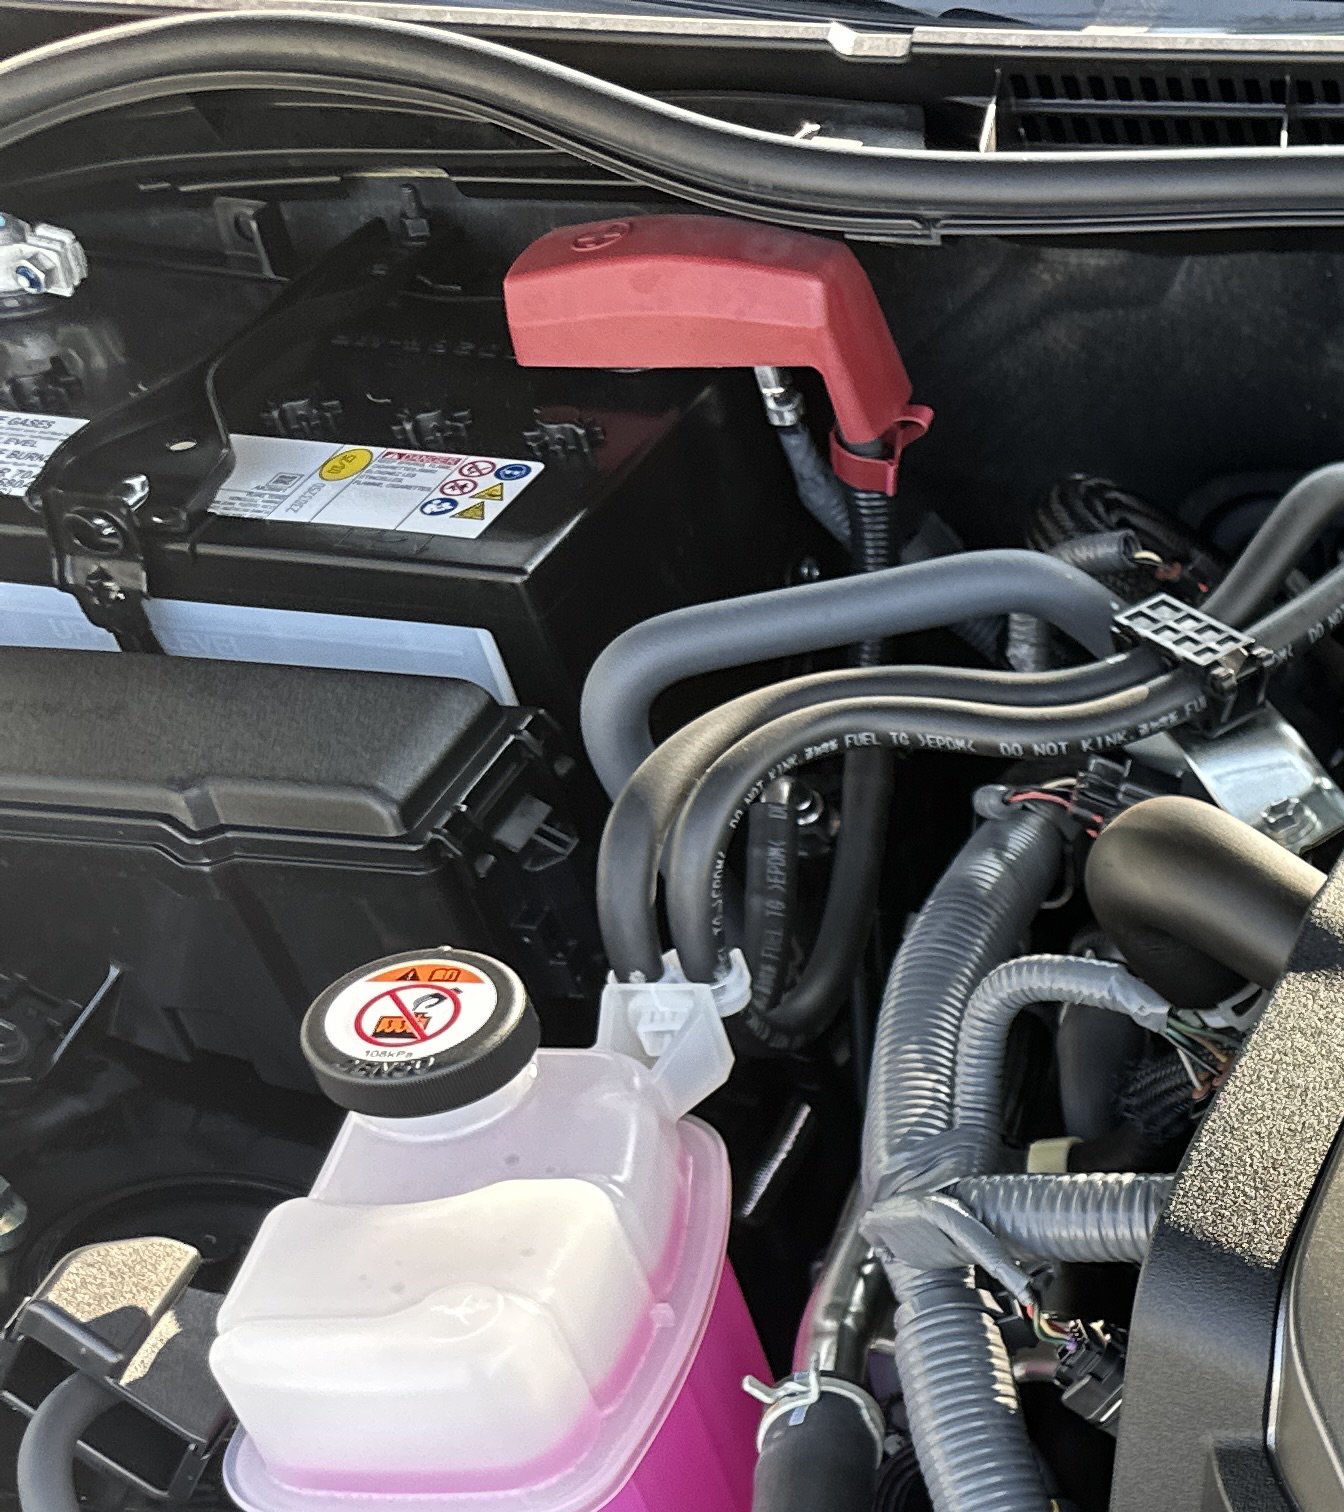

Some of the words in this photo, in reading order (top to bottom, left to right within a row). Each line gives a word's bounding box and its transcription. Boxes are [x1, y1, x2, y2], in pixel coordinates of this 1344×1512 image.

[844, 731, 881, 749] FUEL
[999, 742, 1024, 757] DO
[1033, 741, 1068, 757] NOT
[364, 1049, 414, 1059] 108kPa
